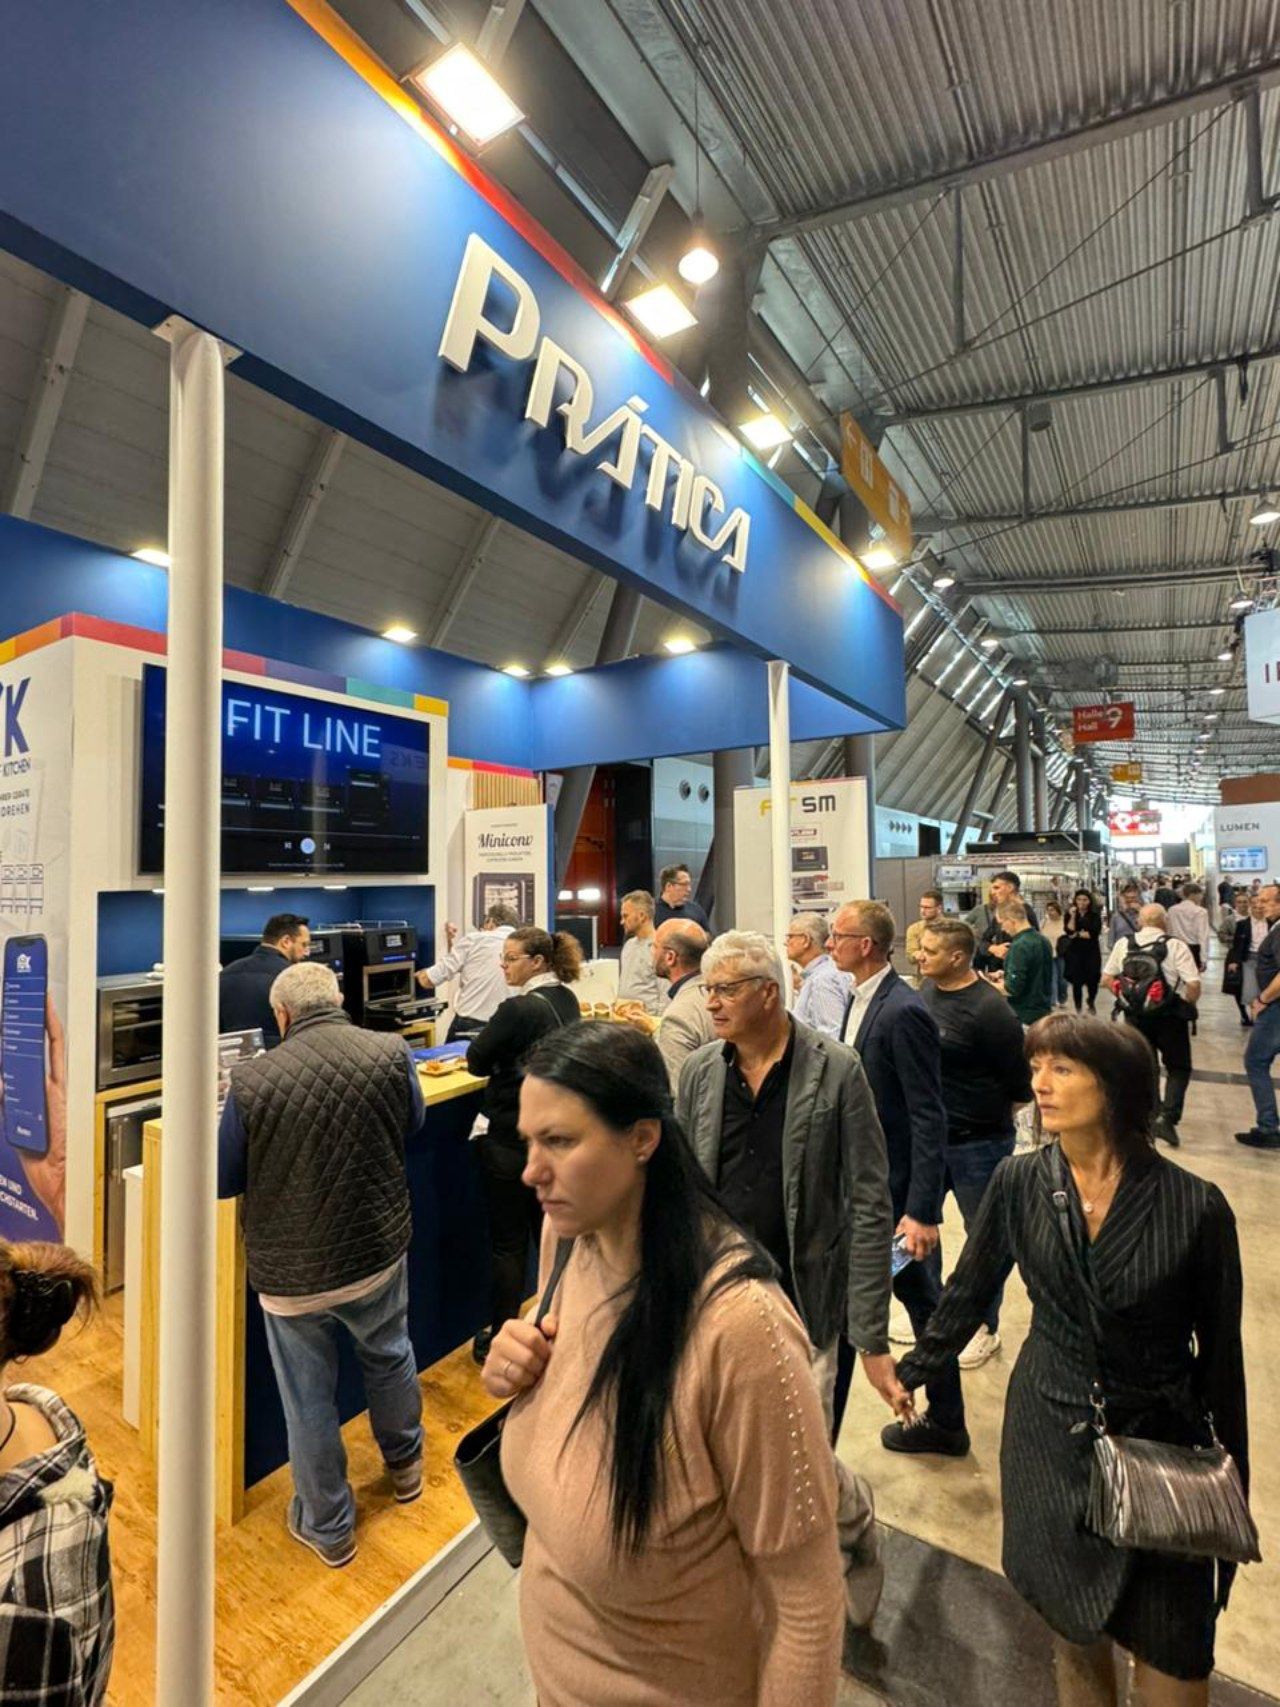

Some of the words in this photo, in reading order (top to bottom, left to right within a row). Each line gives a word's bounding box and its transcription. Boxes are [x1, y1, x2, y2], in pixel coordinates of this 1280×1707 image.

[438, 233, 751, 574] PRÁTICA
[227, 698, 290, 744] FIT
[303, 713, 381, 758] LINE
[1077, 708, 1103, 720] Halle
[1105, 706, 1123, 729] 9
[1077, 721, 1098, 732] Hall
[1220, 822, 1260, 832] LUMEN
